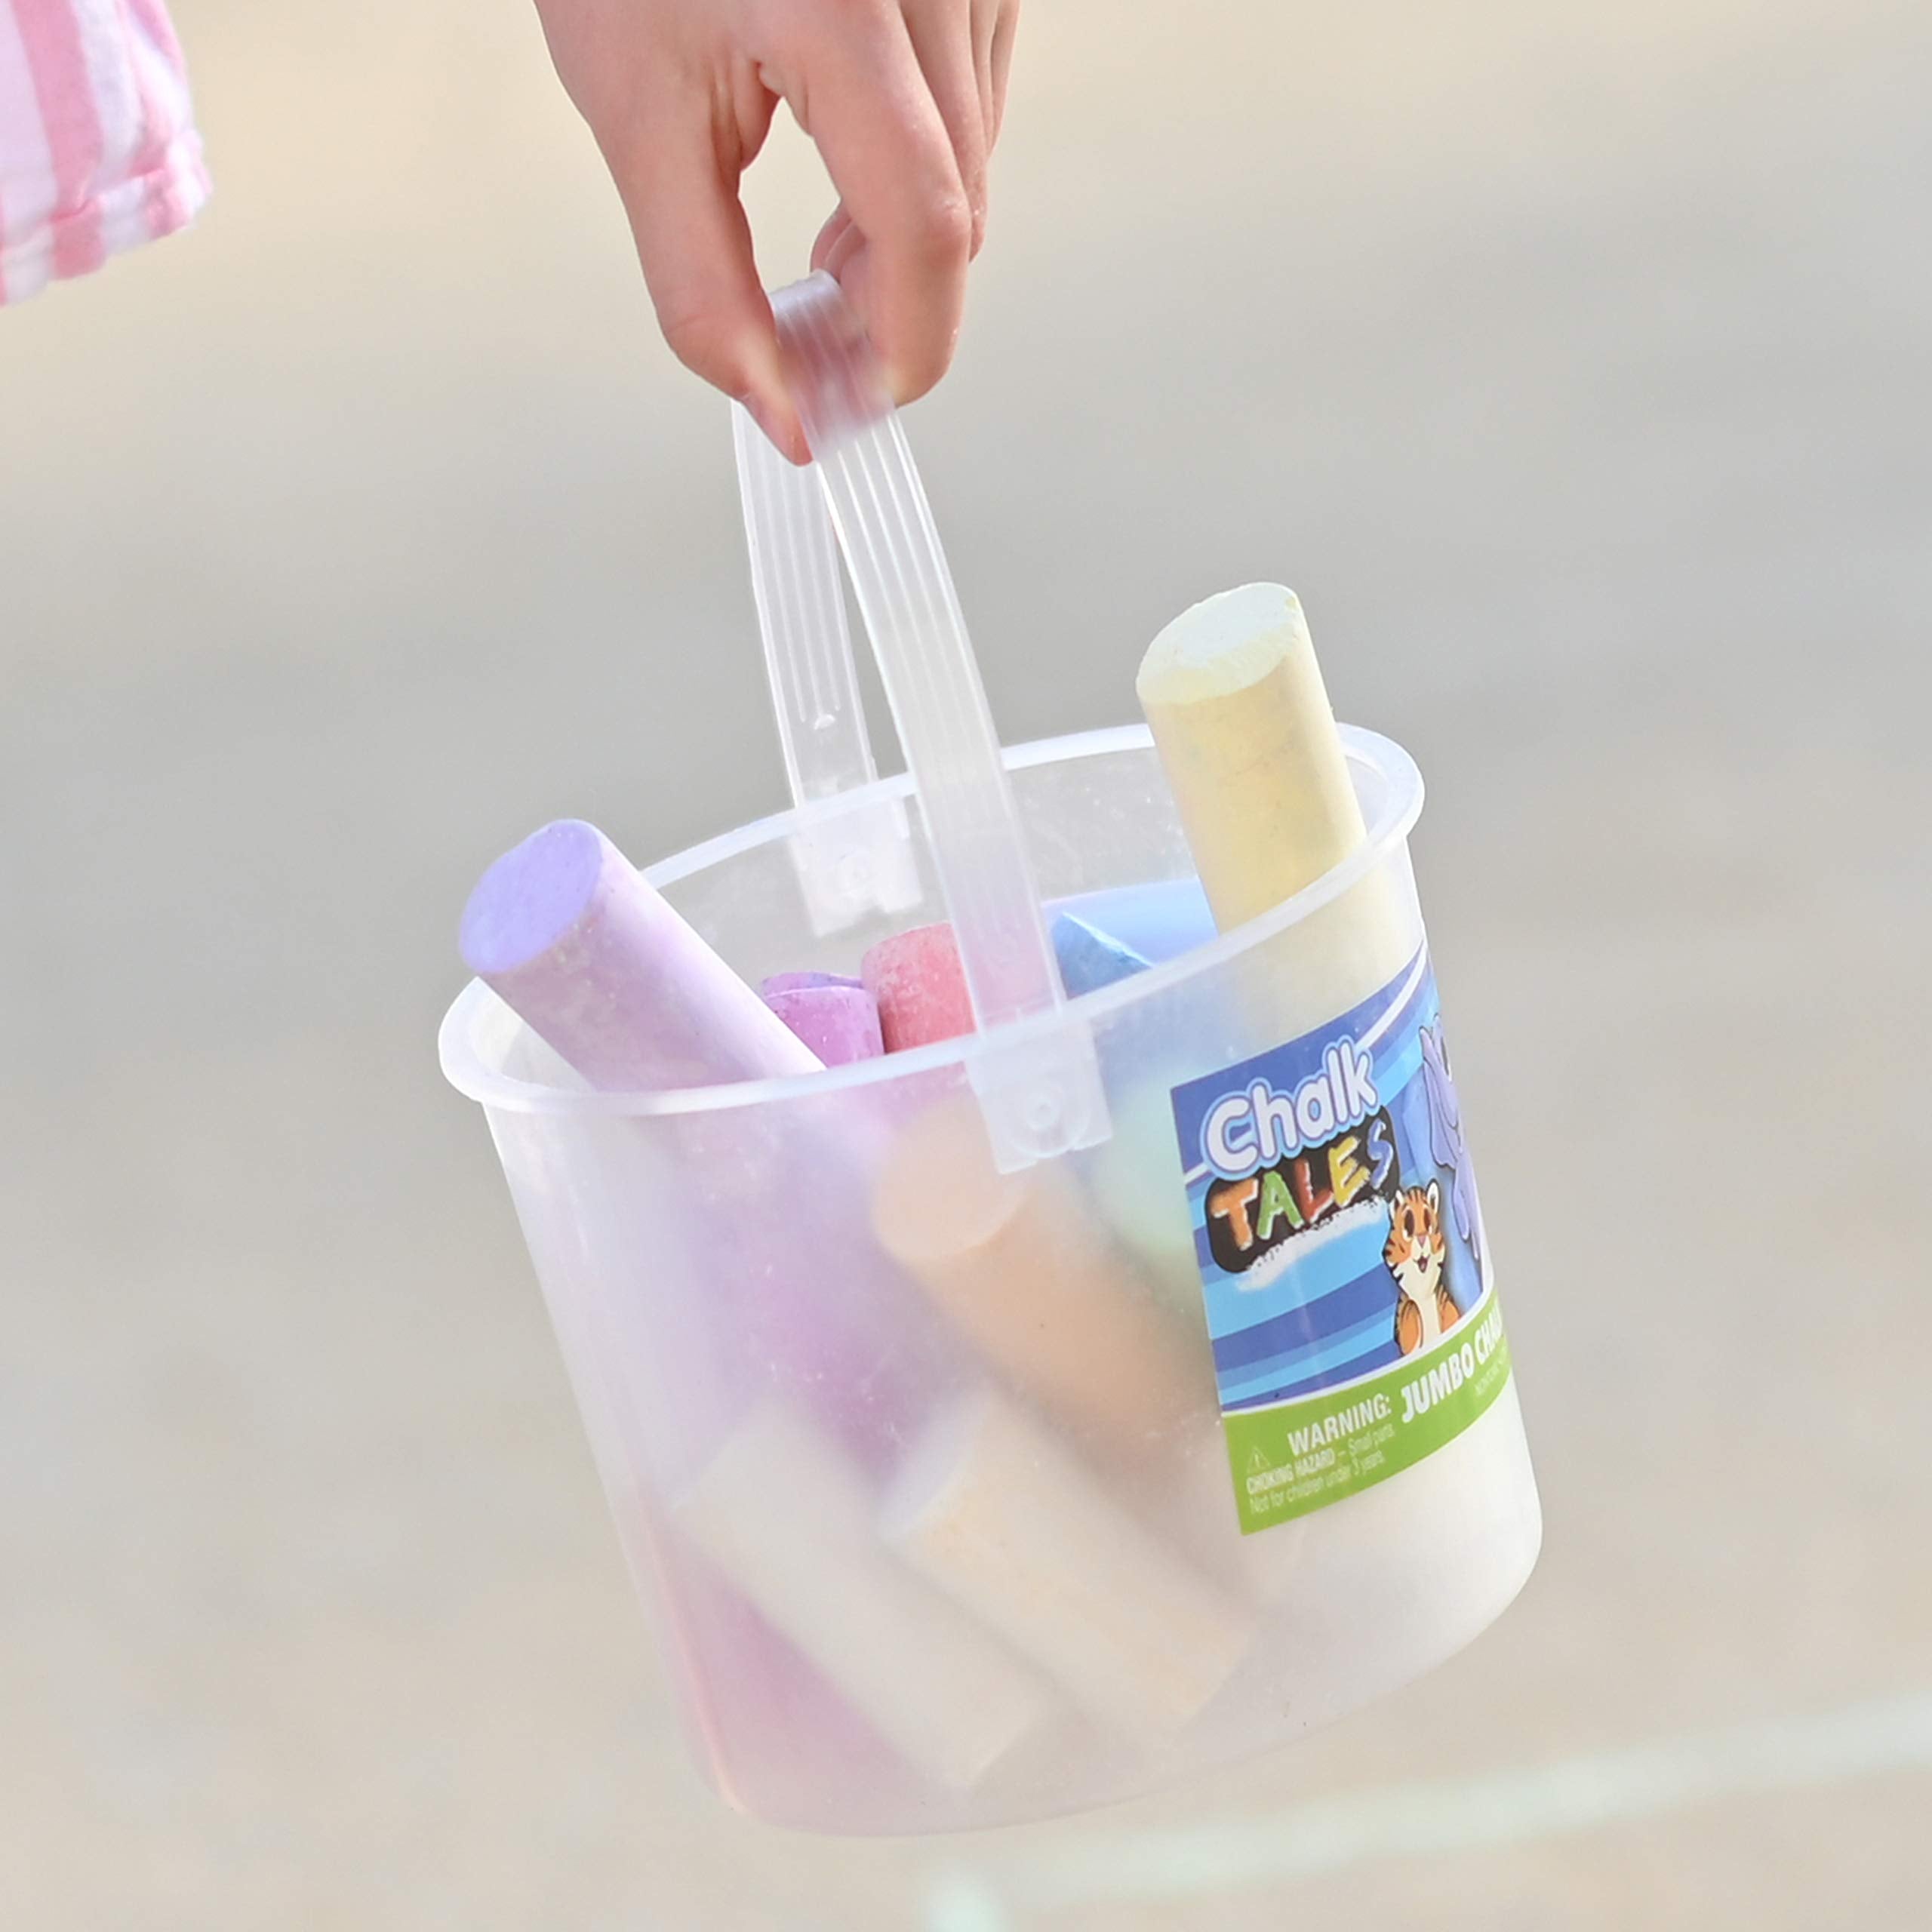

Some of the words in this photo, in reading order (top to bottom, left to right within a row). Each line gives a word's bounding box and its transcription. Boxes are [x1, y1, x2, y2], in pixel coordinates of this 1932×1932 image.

[1205, 1041, 1378, 1174] Chalk
[1210, 1118, 1394, 1251] TALES
[1400, 1340, 1475, 1423] JUMBO
[1287, 1392, 1392, 1456] WARNING:
[1246, 1463, 1294, 1495] CHOKING
[1294, 1447, 1335, 1478] HAZARD
[1347, 1431, 1372, 1457] Small
[1250, 1494, 1269, 1514] Not
[1269, 1489, 1284, 1507] for
[1286, 1476, 1324, 1502] children
[1325, 1465, 1352, 1487] under
